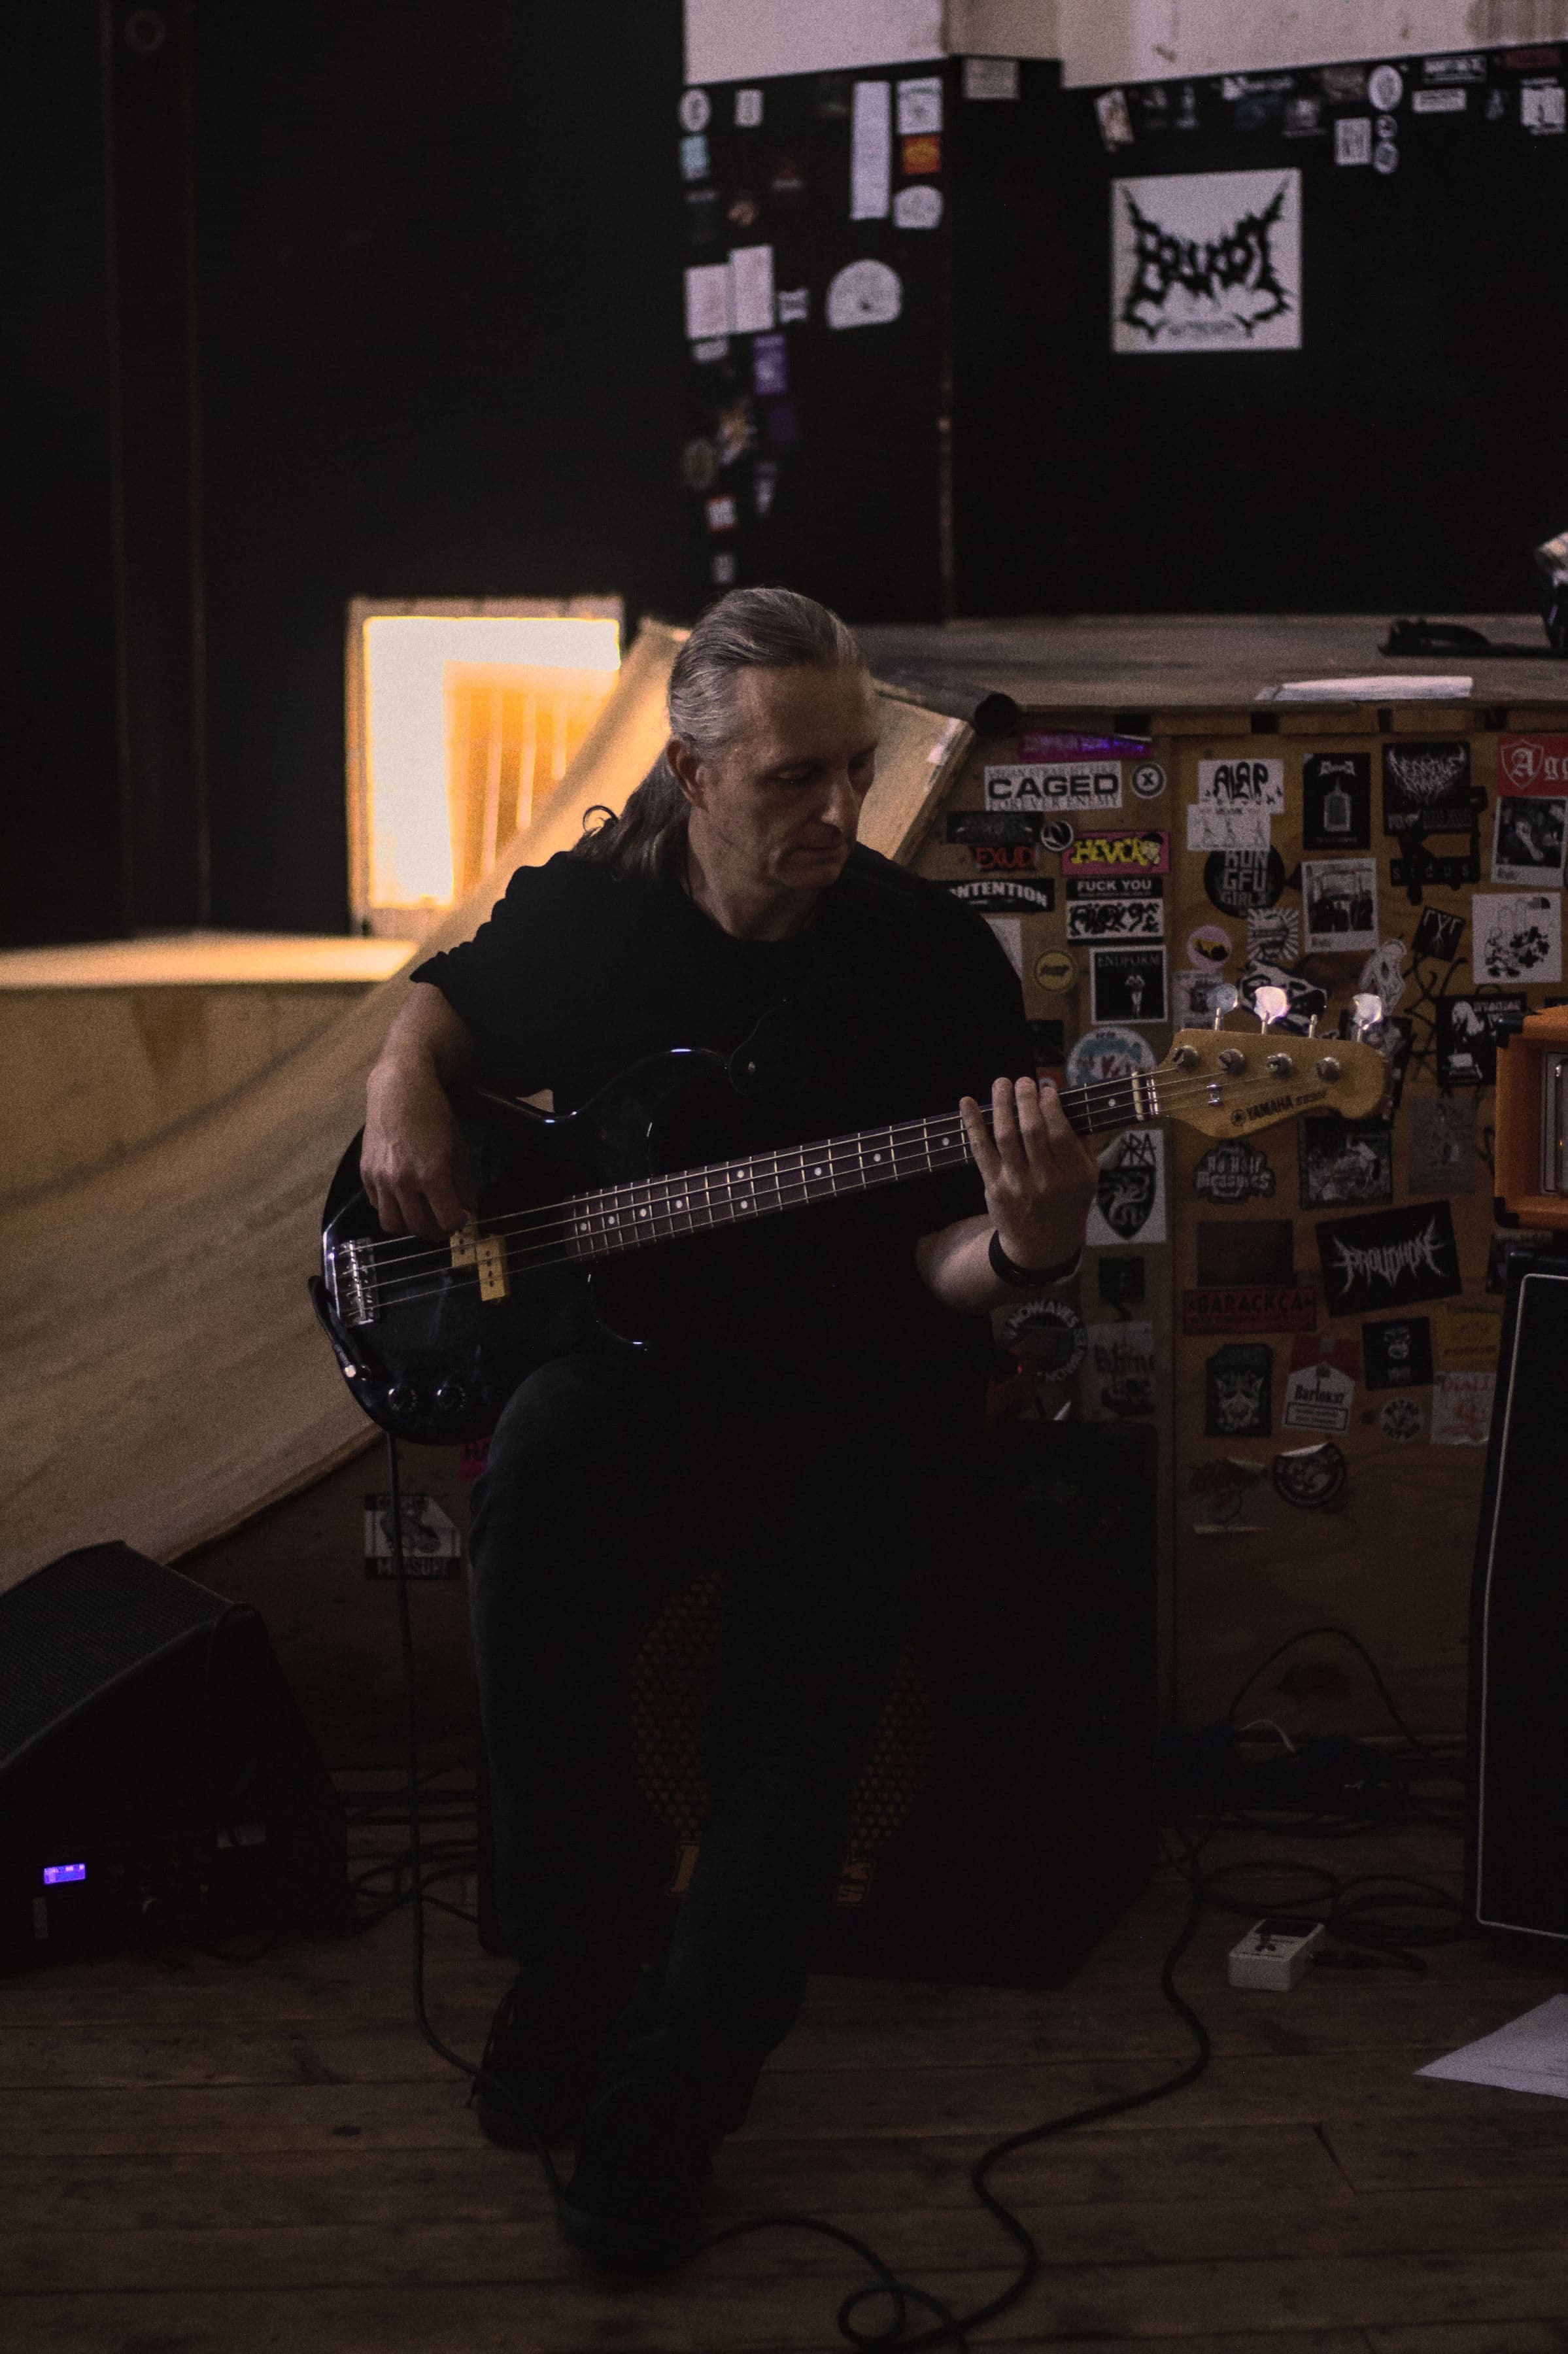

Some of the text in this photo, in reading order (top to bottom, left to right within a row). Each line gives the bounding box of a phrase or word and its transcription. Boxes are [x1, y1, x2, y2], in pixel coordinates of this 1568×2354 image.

[988, 774, 1118, 799] CAGED
[949, 881, 1047, 908] NTENTION
[1077, 879, 1153, 892] FUCK YOU
[1246, 1095, 1294, 1121] YAMAHA
